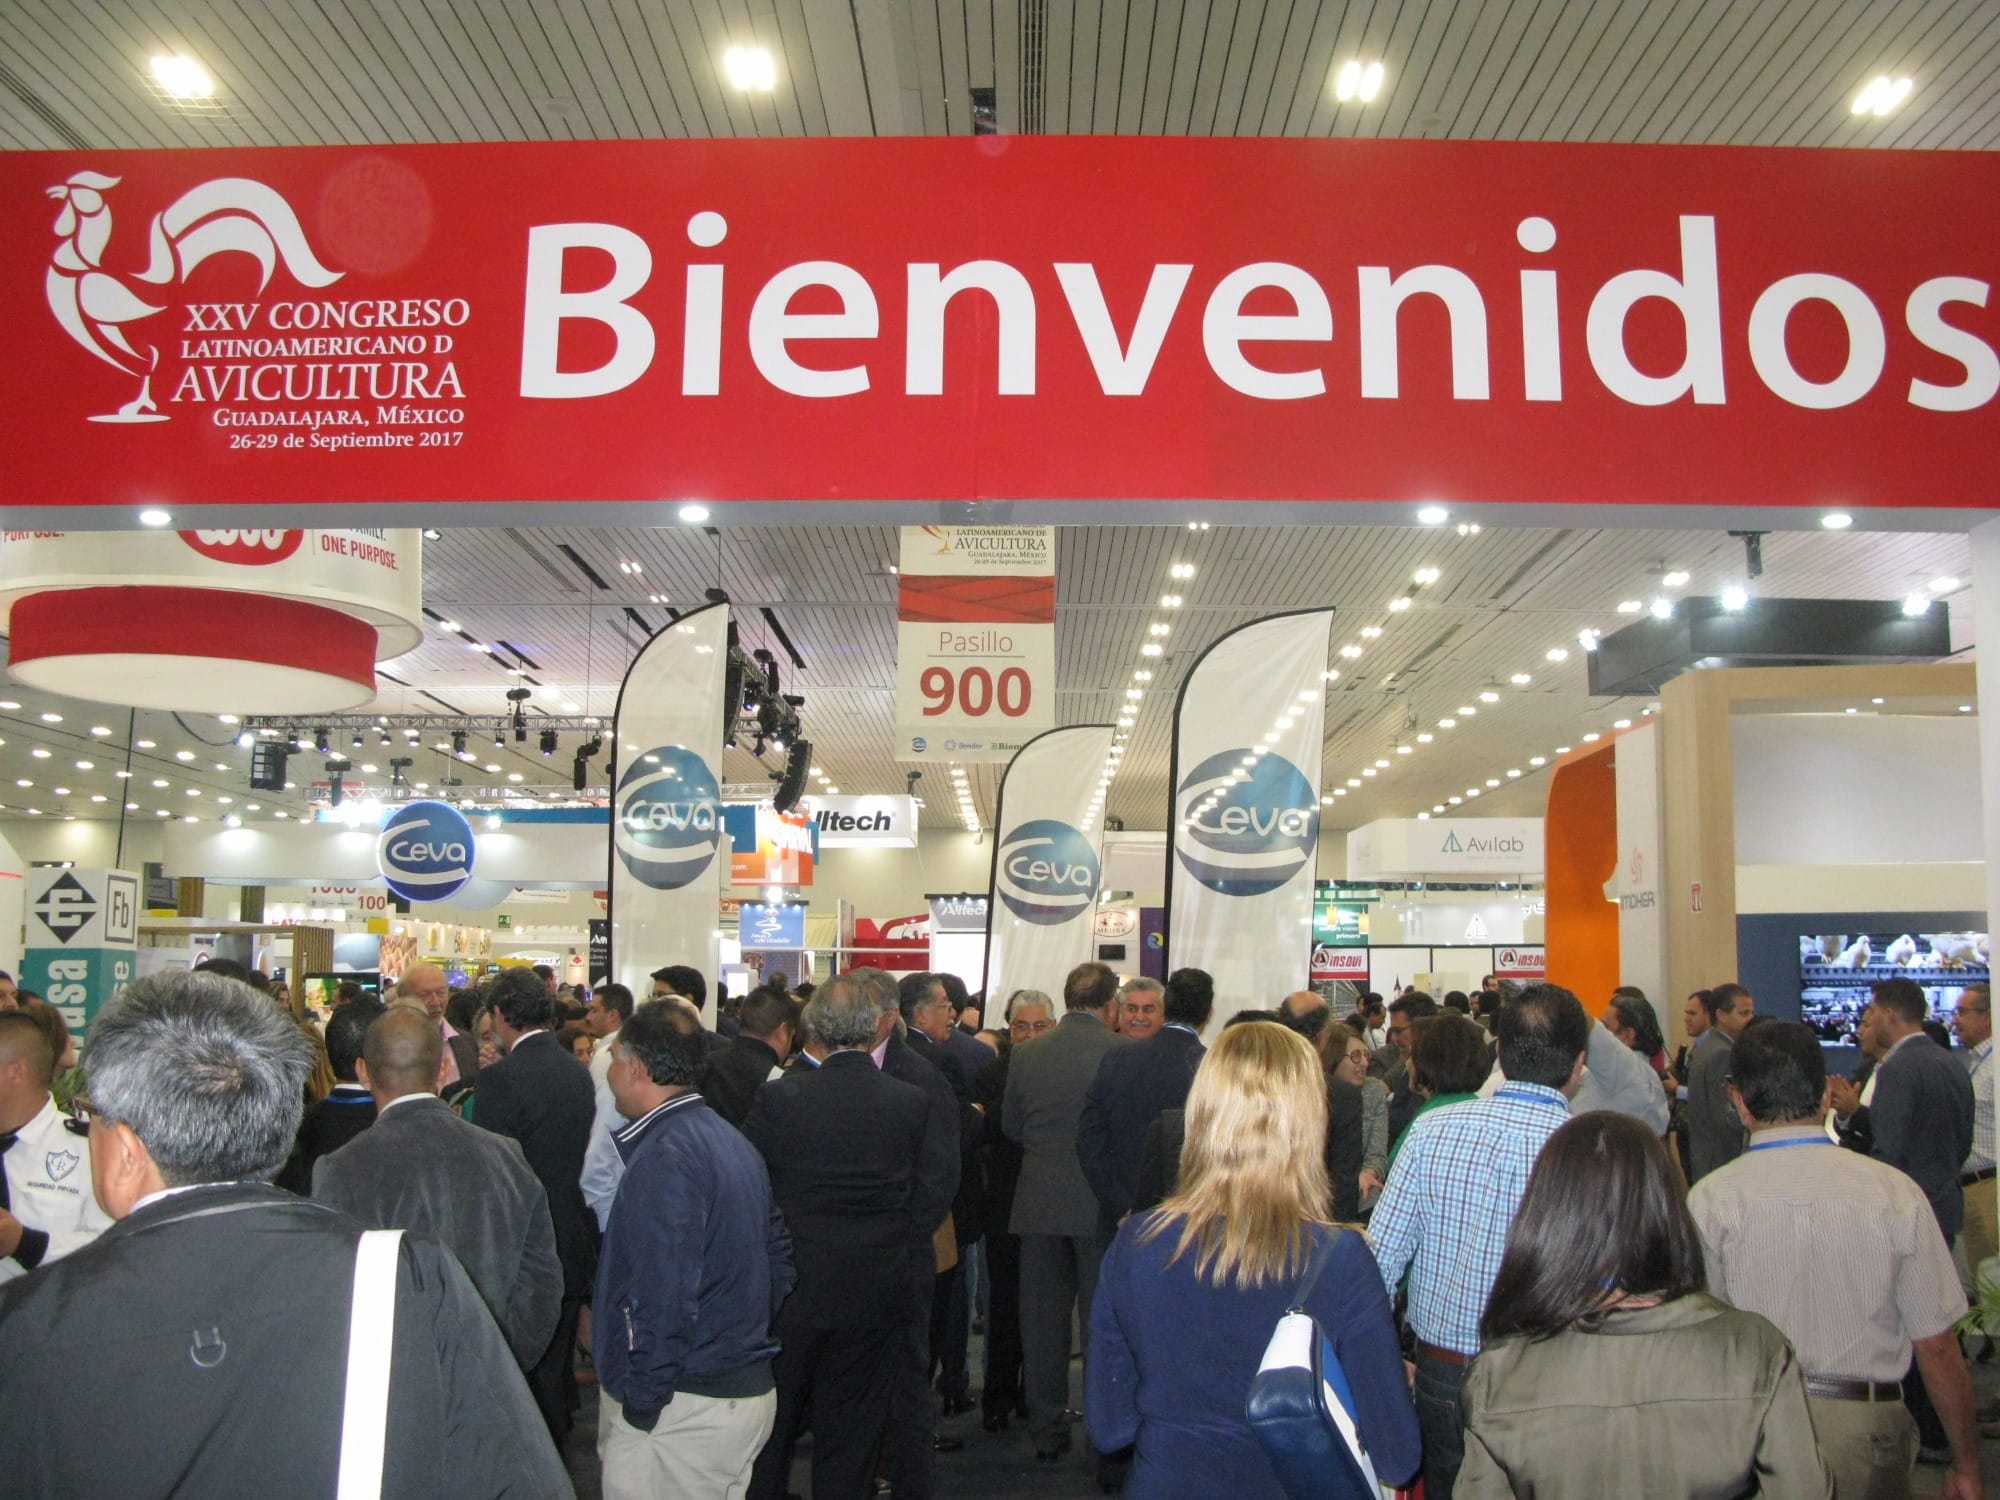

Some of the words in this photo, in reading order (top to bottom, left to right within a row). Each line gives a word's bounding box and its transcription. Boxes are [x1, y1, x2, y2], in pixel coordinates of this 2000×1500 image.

[183, 303, 261, 332] XXV
[268, 298, 471, 331] CONGRESO
[520, 211, 2000, 413] Bienvenidos
[180, 335, 427, 359] LATINOAMERICANO
[433, 334, 453, 355] D
[170, 362, 466, 402] AVICULTURA
[229, 433, 278, 449] 26-29
[283, 432, 305, 449] de
[309, 431, 414, 452] Septiembre
[419, 430, 464, 447] 2017
[321, 534, 348, 556] ONE
[350, 540, 399, 571] PURPOSE.
[954, 537, 1047, 550] AVICULTURA
[939, 630, 1013, 653] Pasillo
[919, 665, 1032, 718] 900
[1467, 837, 1525, 853] Avilab
[358, 895, 386, 911] 100
